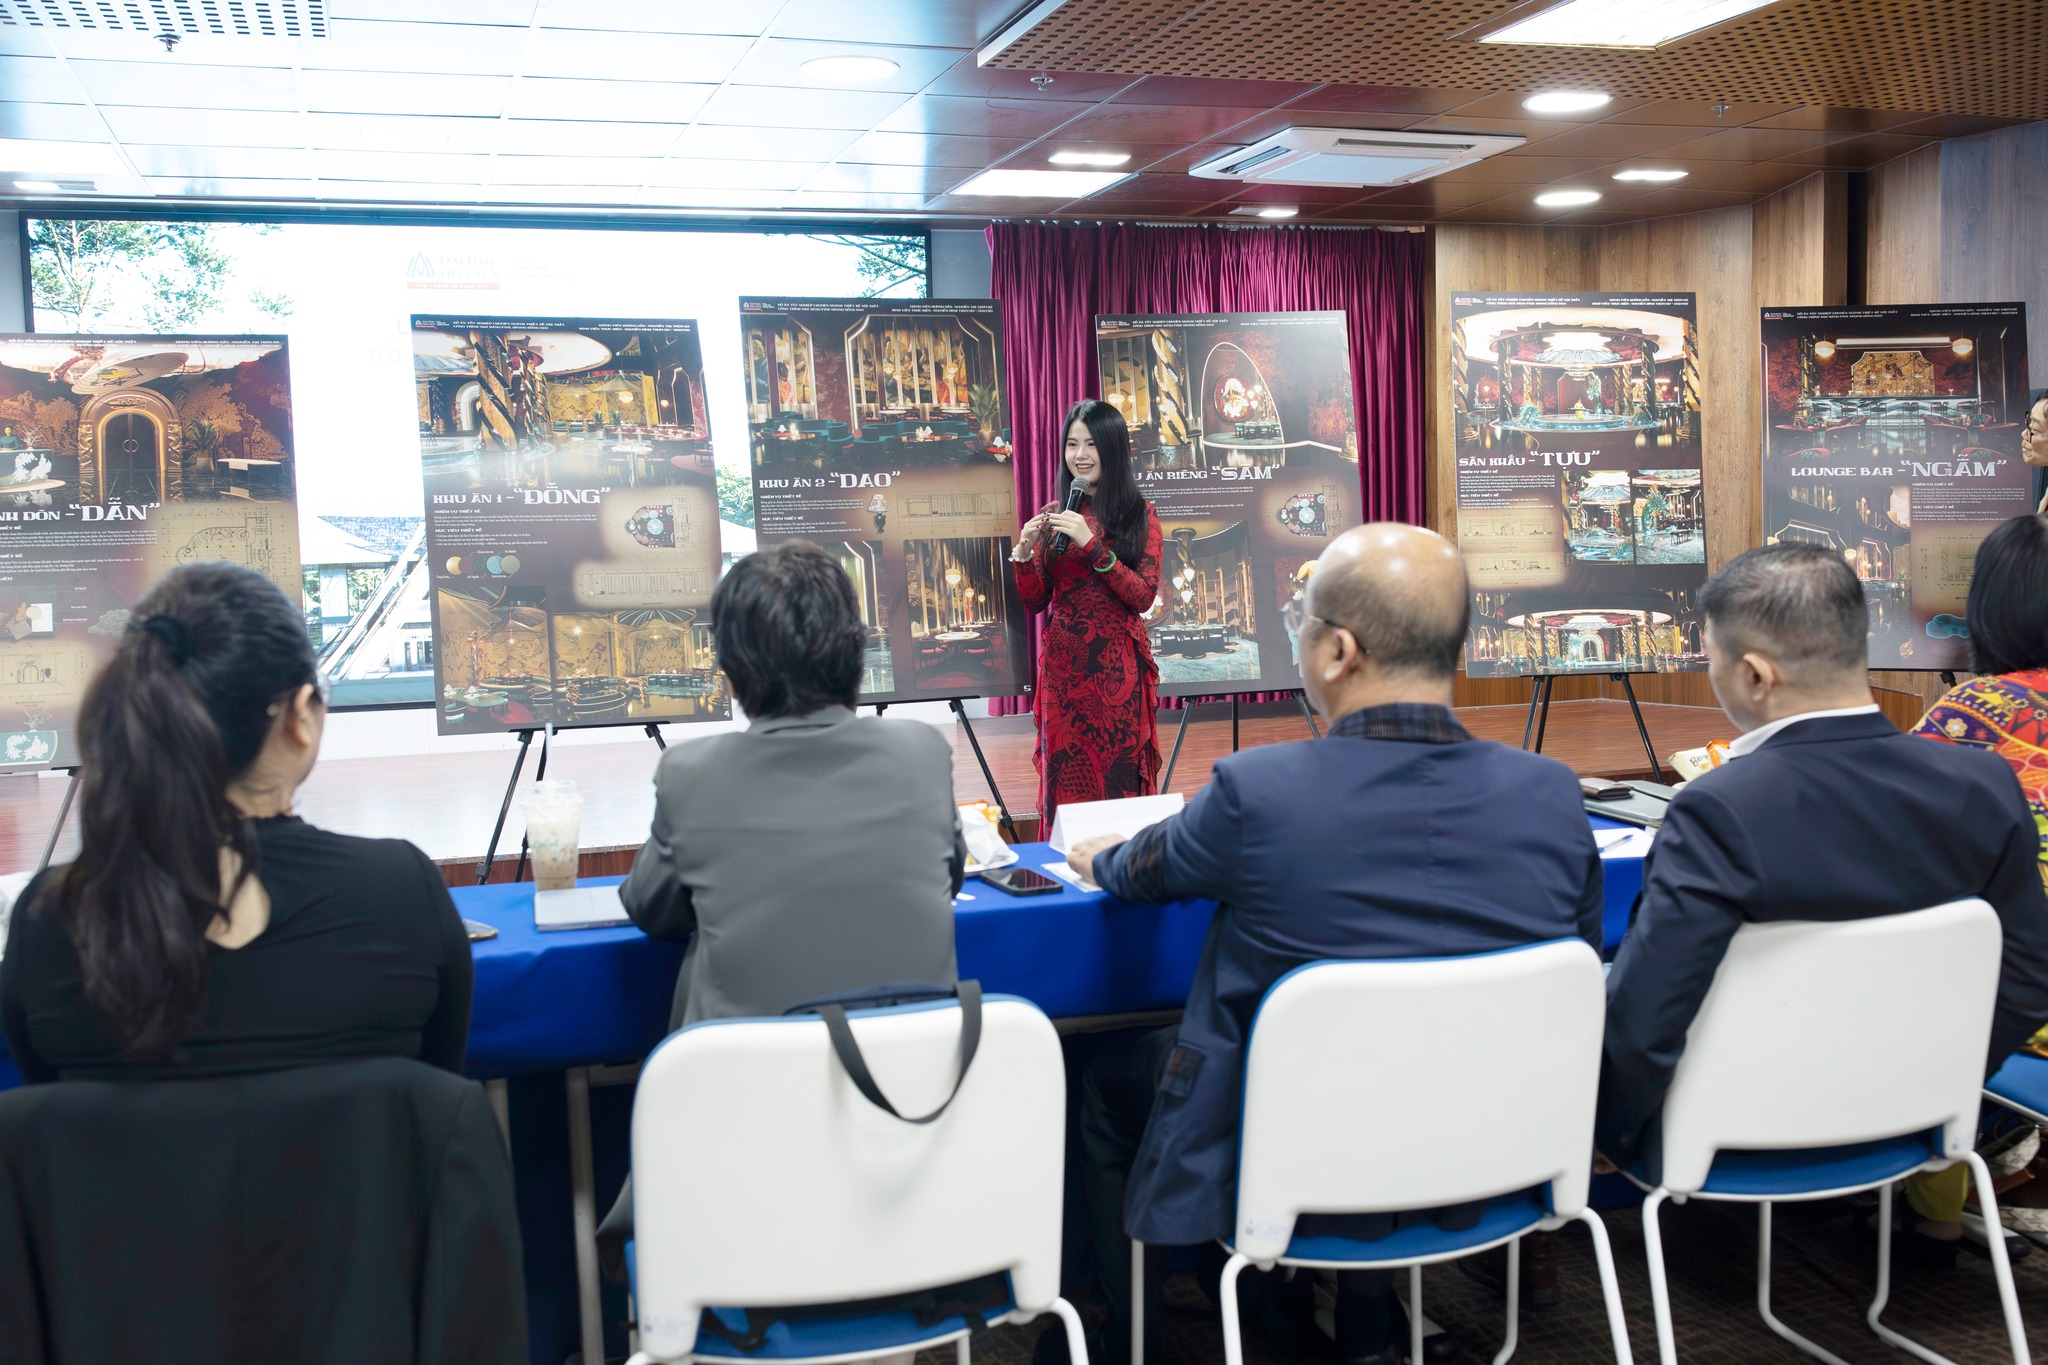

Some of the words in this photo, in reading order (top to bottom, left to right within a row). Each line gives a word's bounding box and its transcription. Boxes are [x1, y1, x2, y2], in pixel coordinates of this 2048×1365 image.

[1791, 466, 1857, 477] LOUNGE
[1859, 466, 1894, 477] BAR
[758, 479, 789, 488] KHU
[815, 478, 825, 488] 2
[432, 494, 467, 504] KHU
[496, 494, 503, 504] 1
